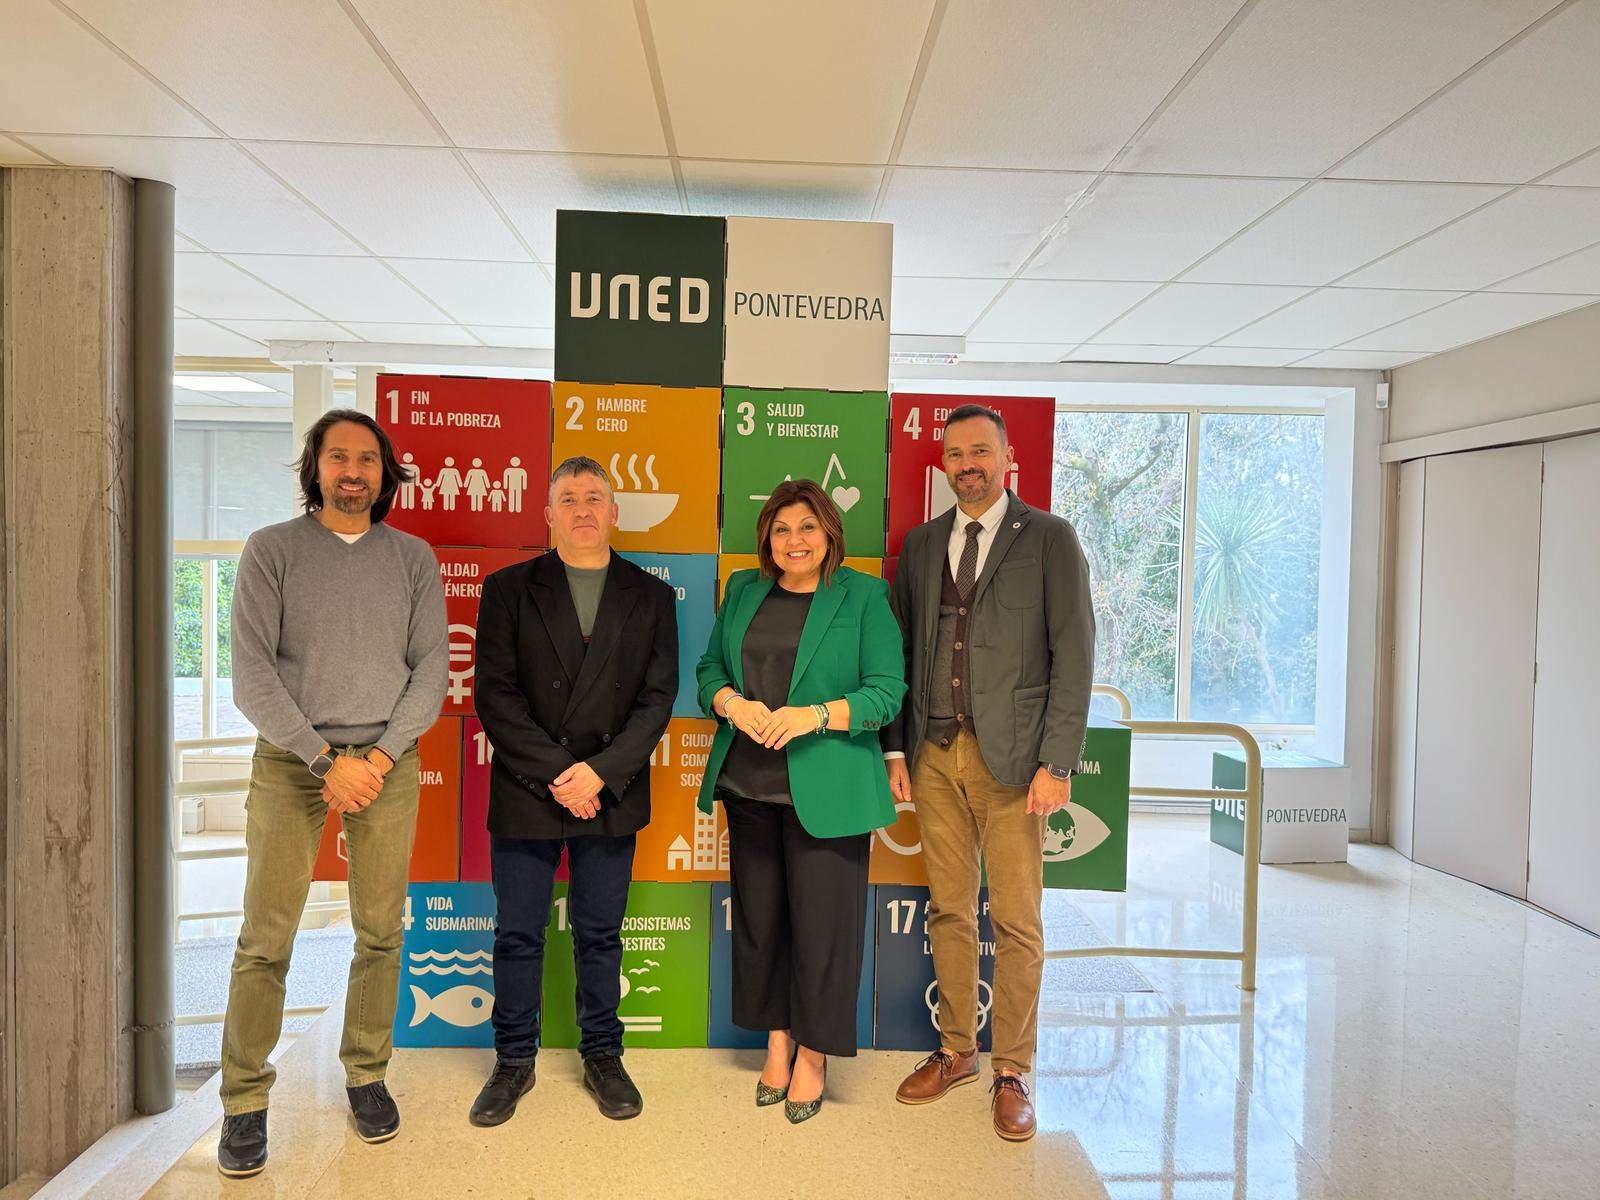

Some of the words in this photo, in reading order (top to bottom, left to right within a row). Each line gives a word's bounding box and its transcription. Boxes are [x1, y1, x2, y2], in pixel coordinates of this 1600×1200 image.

[570, 271, 710, 324] UNED
[734, 291, 885, 322] PONTEVEDRA
[411, 390, 430, 405] FIN
[596, 397, 647, 413] HAMBRE
[386, 389, 400, 425] 1
[565, 395, 585, 431] 2
[767, 402, 805, 418] SALUD
[411, 411, 427, 426] DE
[429, 411, 444, 427] LA
[447, 412, 502, 429] POBREZA
[596, 417, 629, 432] CERO
[736, 401, 756, 436] 3
[902, 407, 923, 441] 4
[767, 423, 775, 437] Y
[777, 423, 839, 439] BIENESTAR
[1266, 808, 1347, 823] PONTEVEDRA
[426, 896, 453, 911] VIDA
[425, 916, 495, 931] SUBMARINA
[886, 899, 917, 934] 17
